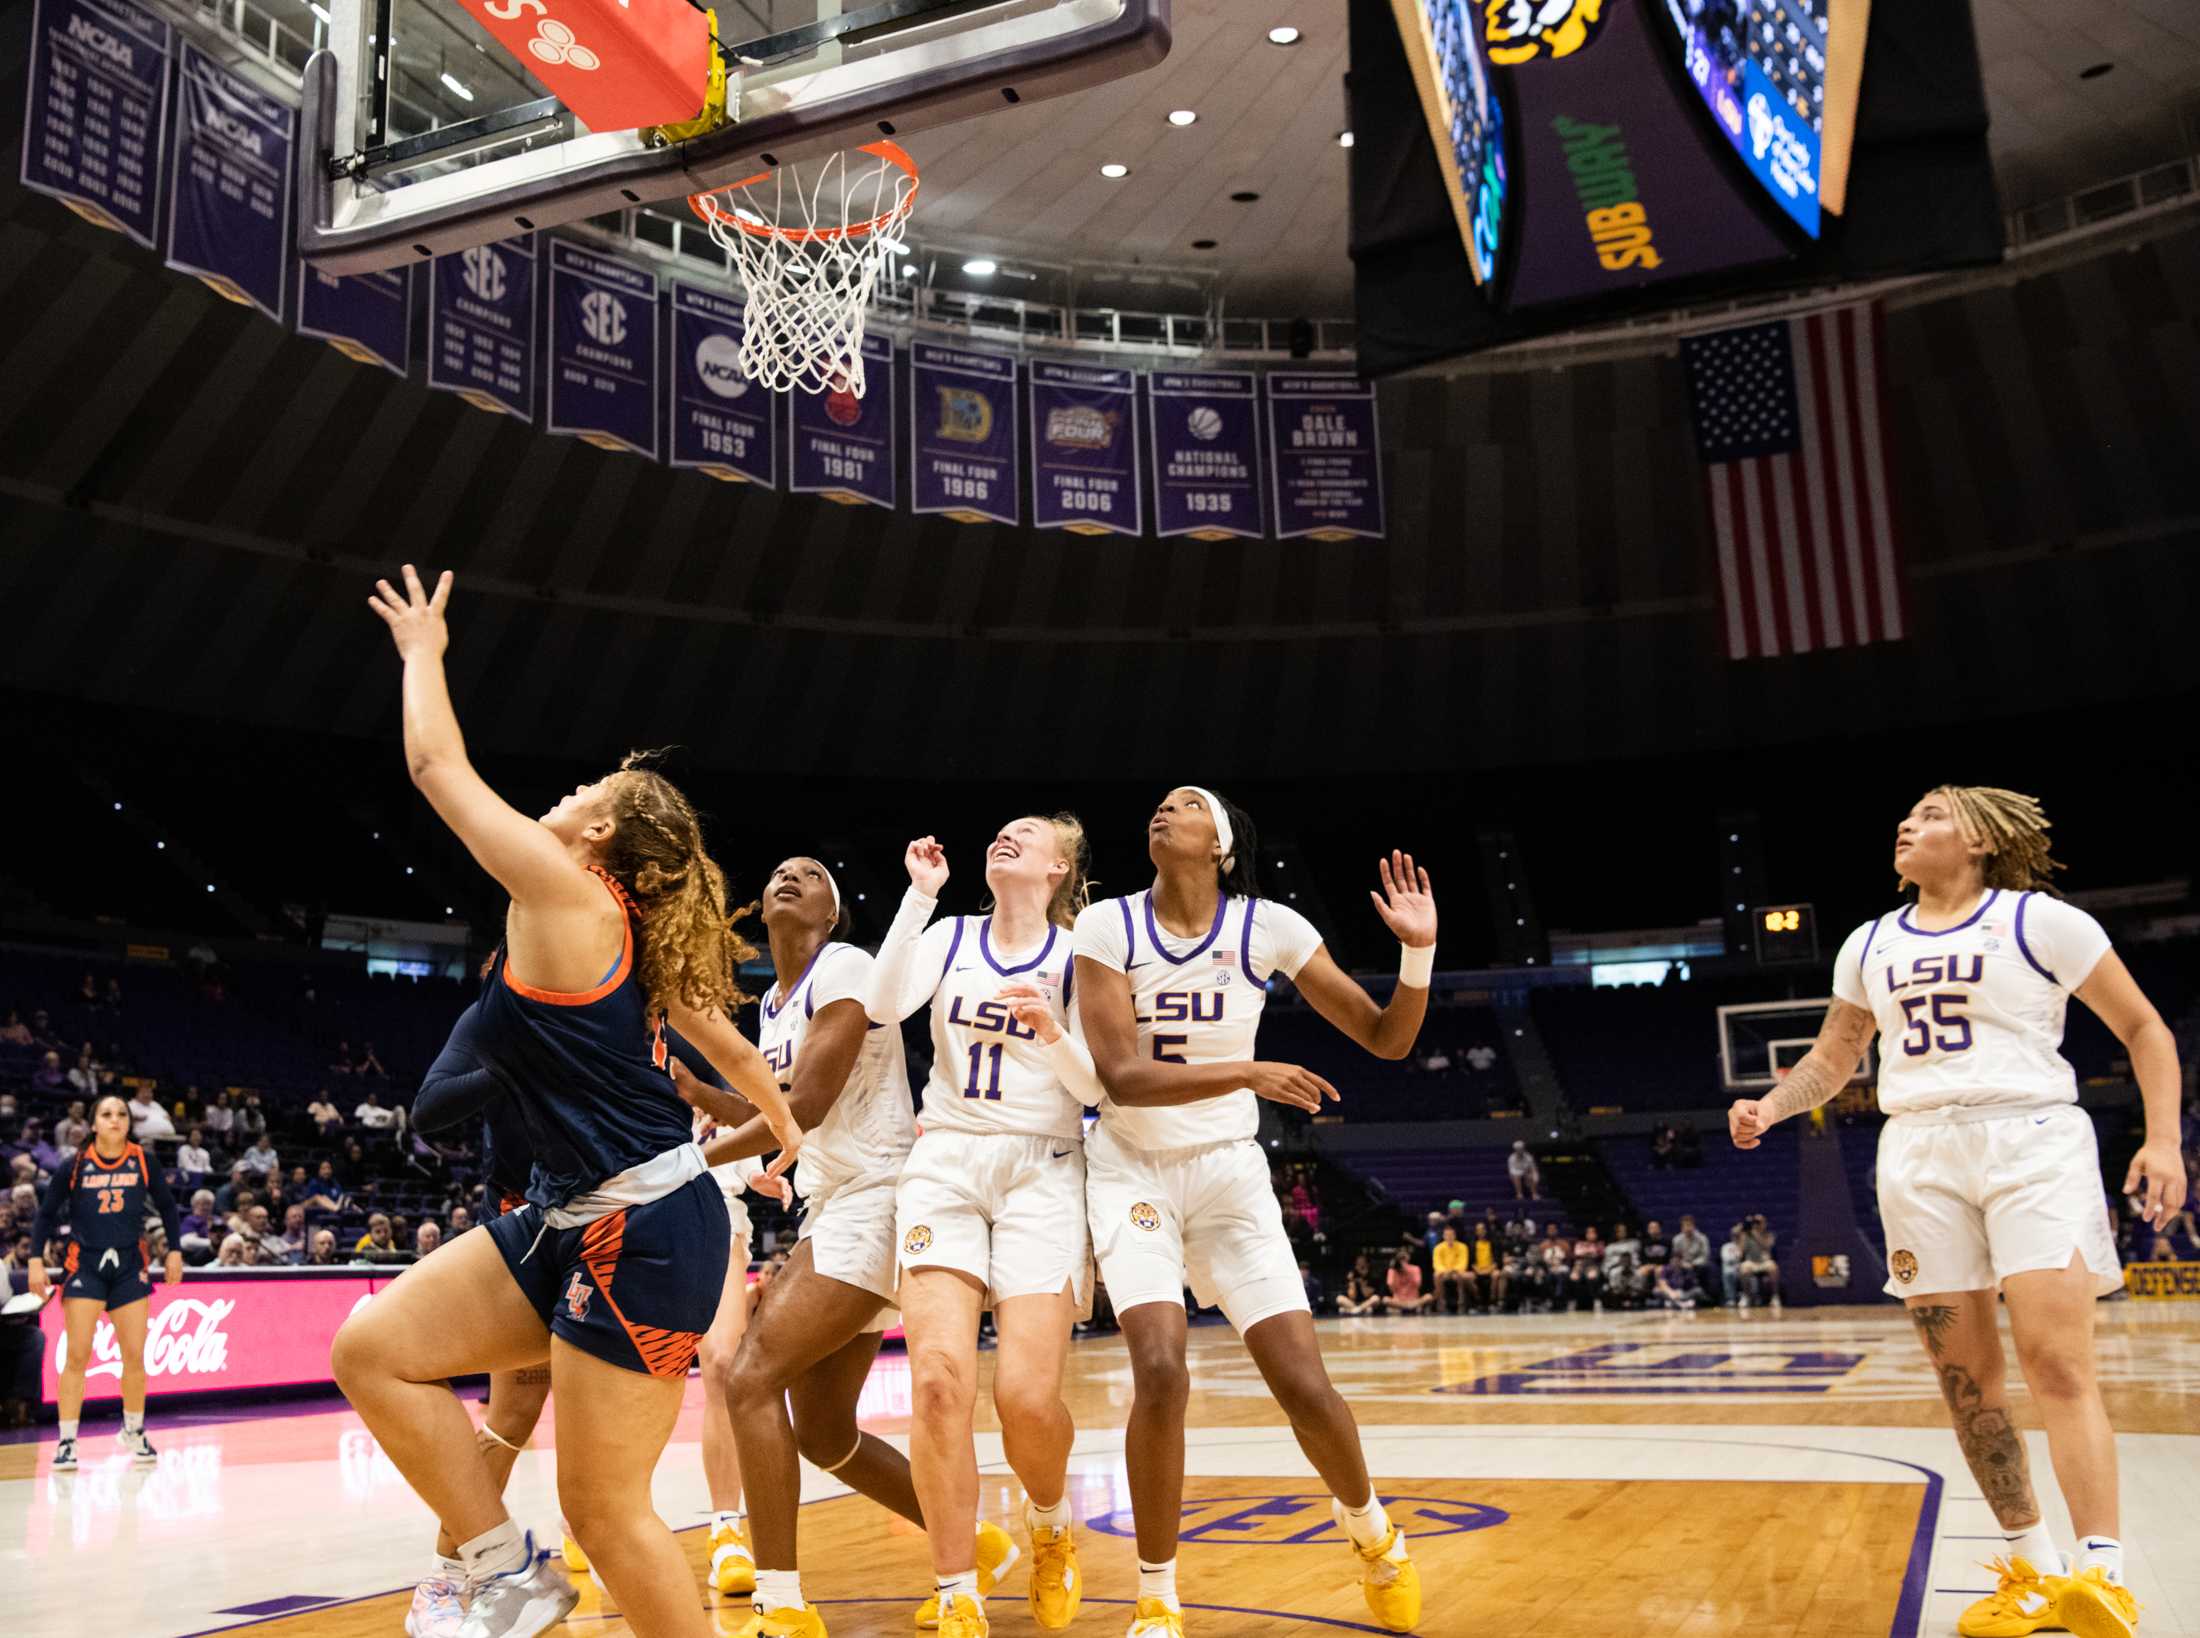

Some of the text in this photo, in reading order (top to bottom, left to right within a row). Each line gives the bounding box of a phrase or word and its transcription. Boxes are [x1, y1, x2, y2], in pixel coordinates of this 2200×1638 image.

[68, 14, 133, 69] NCAA
[206, 107, 263, 155] NCAA
[1552, 114, 1663, 271] SUBWAY
[462, 246, 507, 302] SEC
[580, 290, 627, 345] SEC
[575, 344, 633, 370] CHAMPIONS
[692, 411, 755, 438] FINAL FOUR
[1302, 415, 1345, 431] DALE
[702, 430, 746, 458] 1953
[811, 439, 875, 462] FINAL FOUR
[1293, 431, 1358, 447] BROWN
[823, 457, 863, 481] 1981
[1174, 450, 1238, 464] NATIONAL
[933, 461, 998, 481] FINAL FOUR
[1054, 474, 1119, 493] FINAL FOUR
[1168, 465, 1248, 479] CHAMPIONS
[943, 478, 988, 500] 1986
[1062, 491, 1111, 512] 2006
[1186, 493, 1232, 512] 1935
[1886, 955, 1984, 993] LSU
[947, 995, 1036, 1041] LSU
[1900, 994, 1973, 1057] 55
[762, 1038, 793, 1072] SU
[963, 1042, 1003, 1101] 11
[97, 1189, 125, 1215] 23
